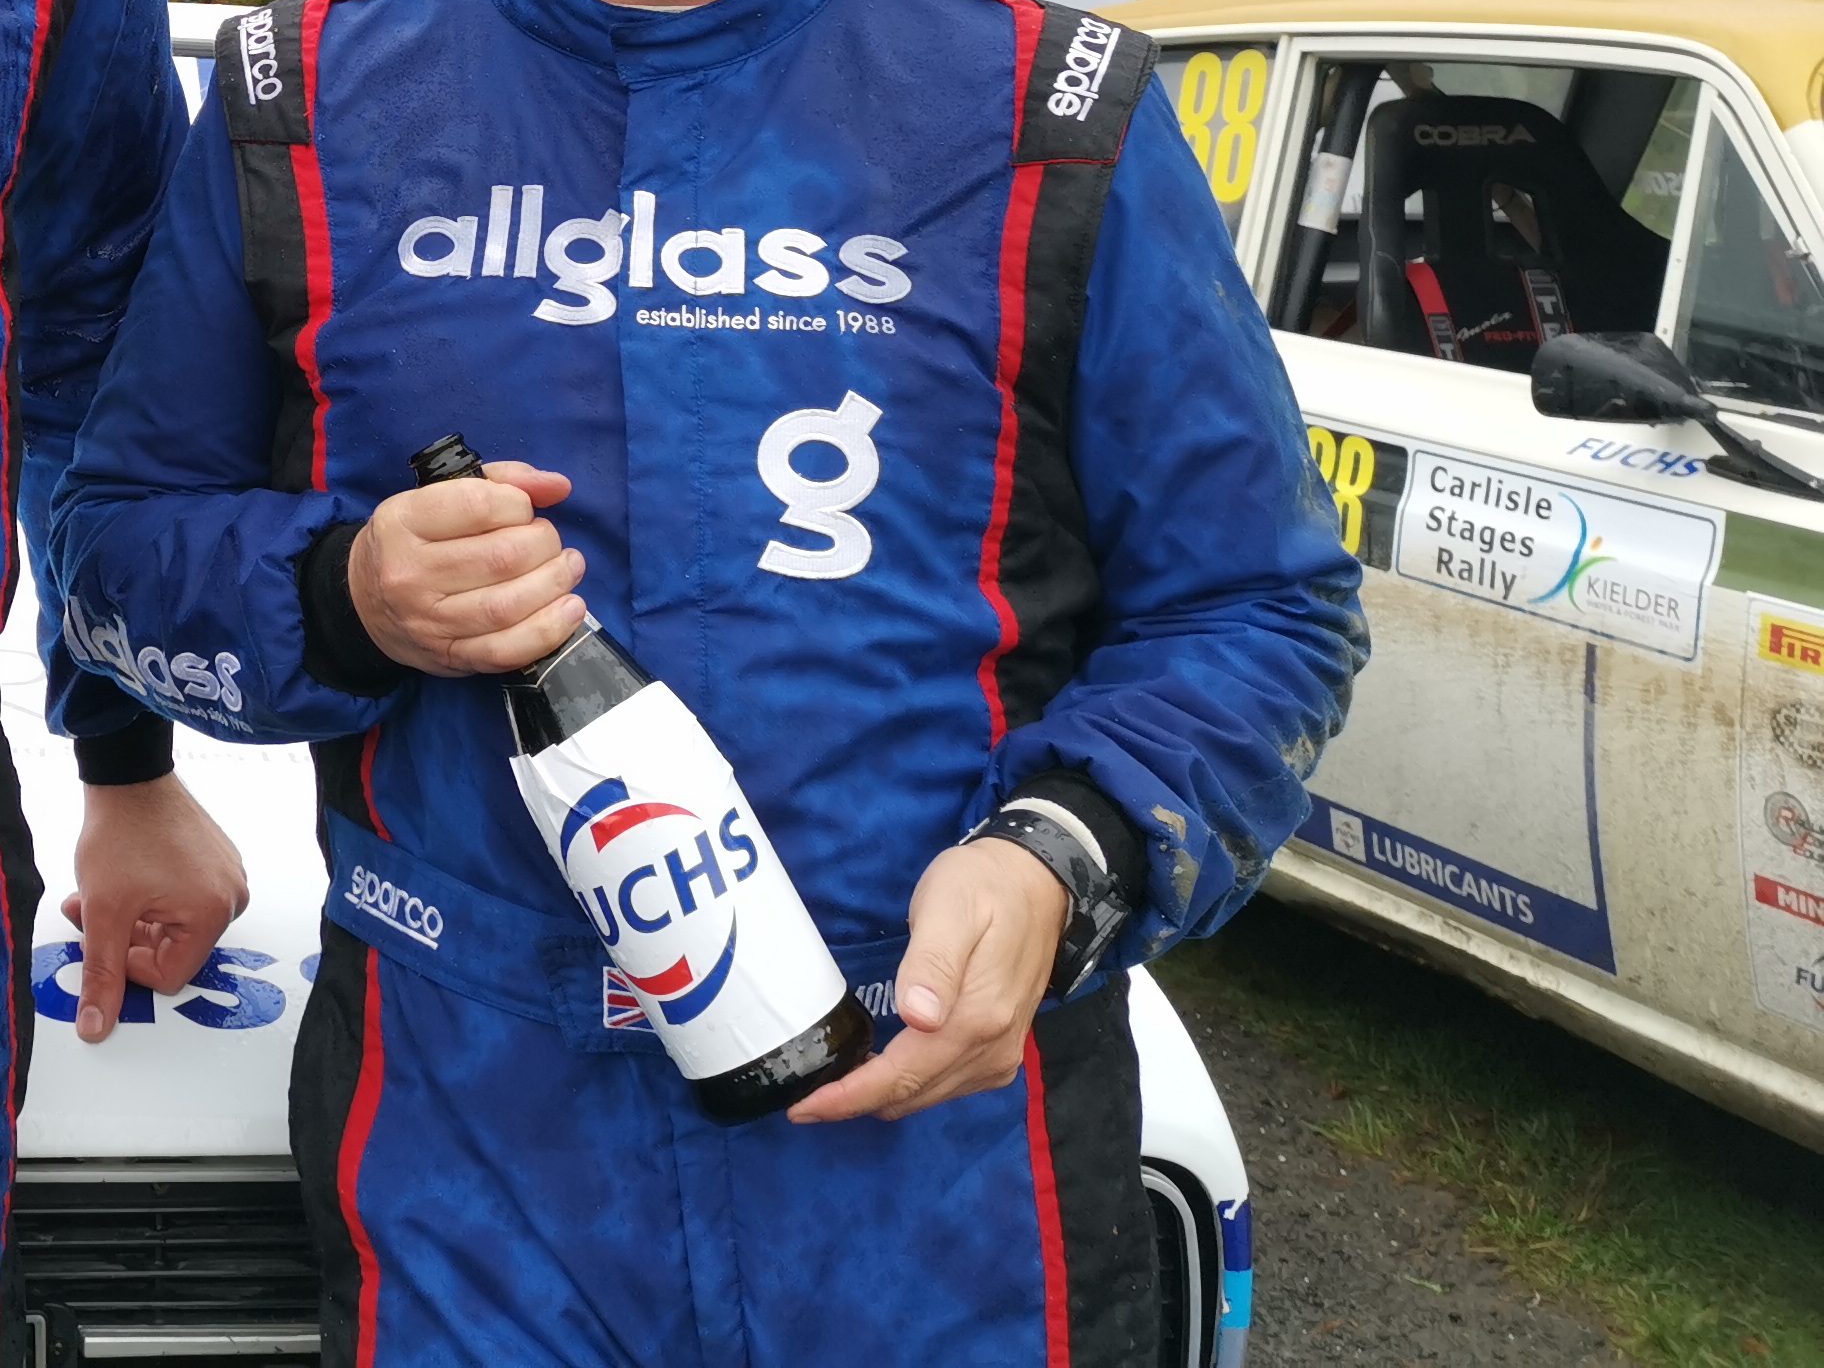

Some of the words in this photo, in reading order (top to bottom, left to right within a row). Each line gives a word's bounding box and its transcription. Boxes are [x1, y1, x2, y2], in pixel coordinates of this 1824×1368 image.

[237, 9, 283, 102] sparco
[1047, 17, 1113, 117] sparco
[1414, 123, 1537, 146] COBRA
[398, 184, 912, 326] allglass
[636, 305, 760, 329] established
[767, 310, 827, 331] since
[836, 310, 896, 335] 1988
[757, 390, 883, 579] g
[1567, 438, 1707, 477] FUCHS
[1429, 465, 1553, 519] Carlisle
[1425, 506, 1534, 558] Stages
[1437, 547, 1517, 601] Rally
[1586, 575, 1680, 621] KIELDER
[349, 865, 443, 942] sparco
[577, 806, 759, 947] UCHS
[1372, 832, 1534, 924] LUBRICANTS
